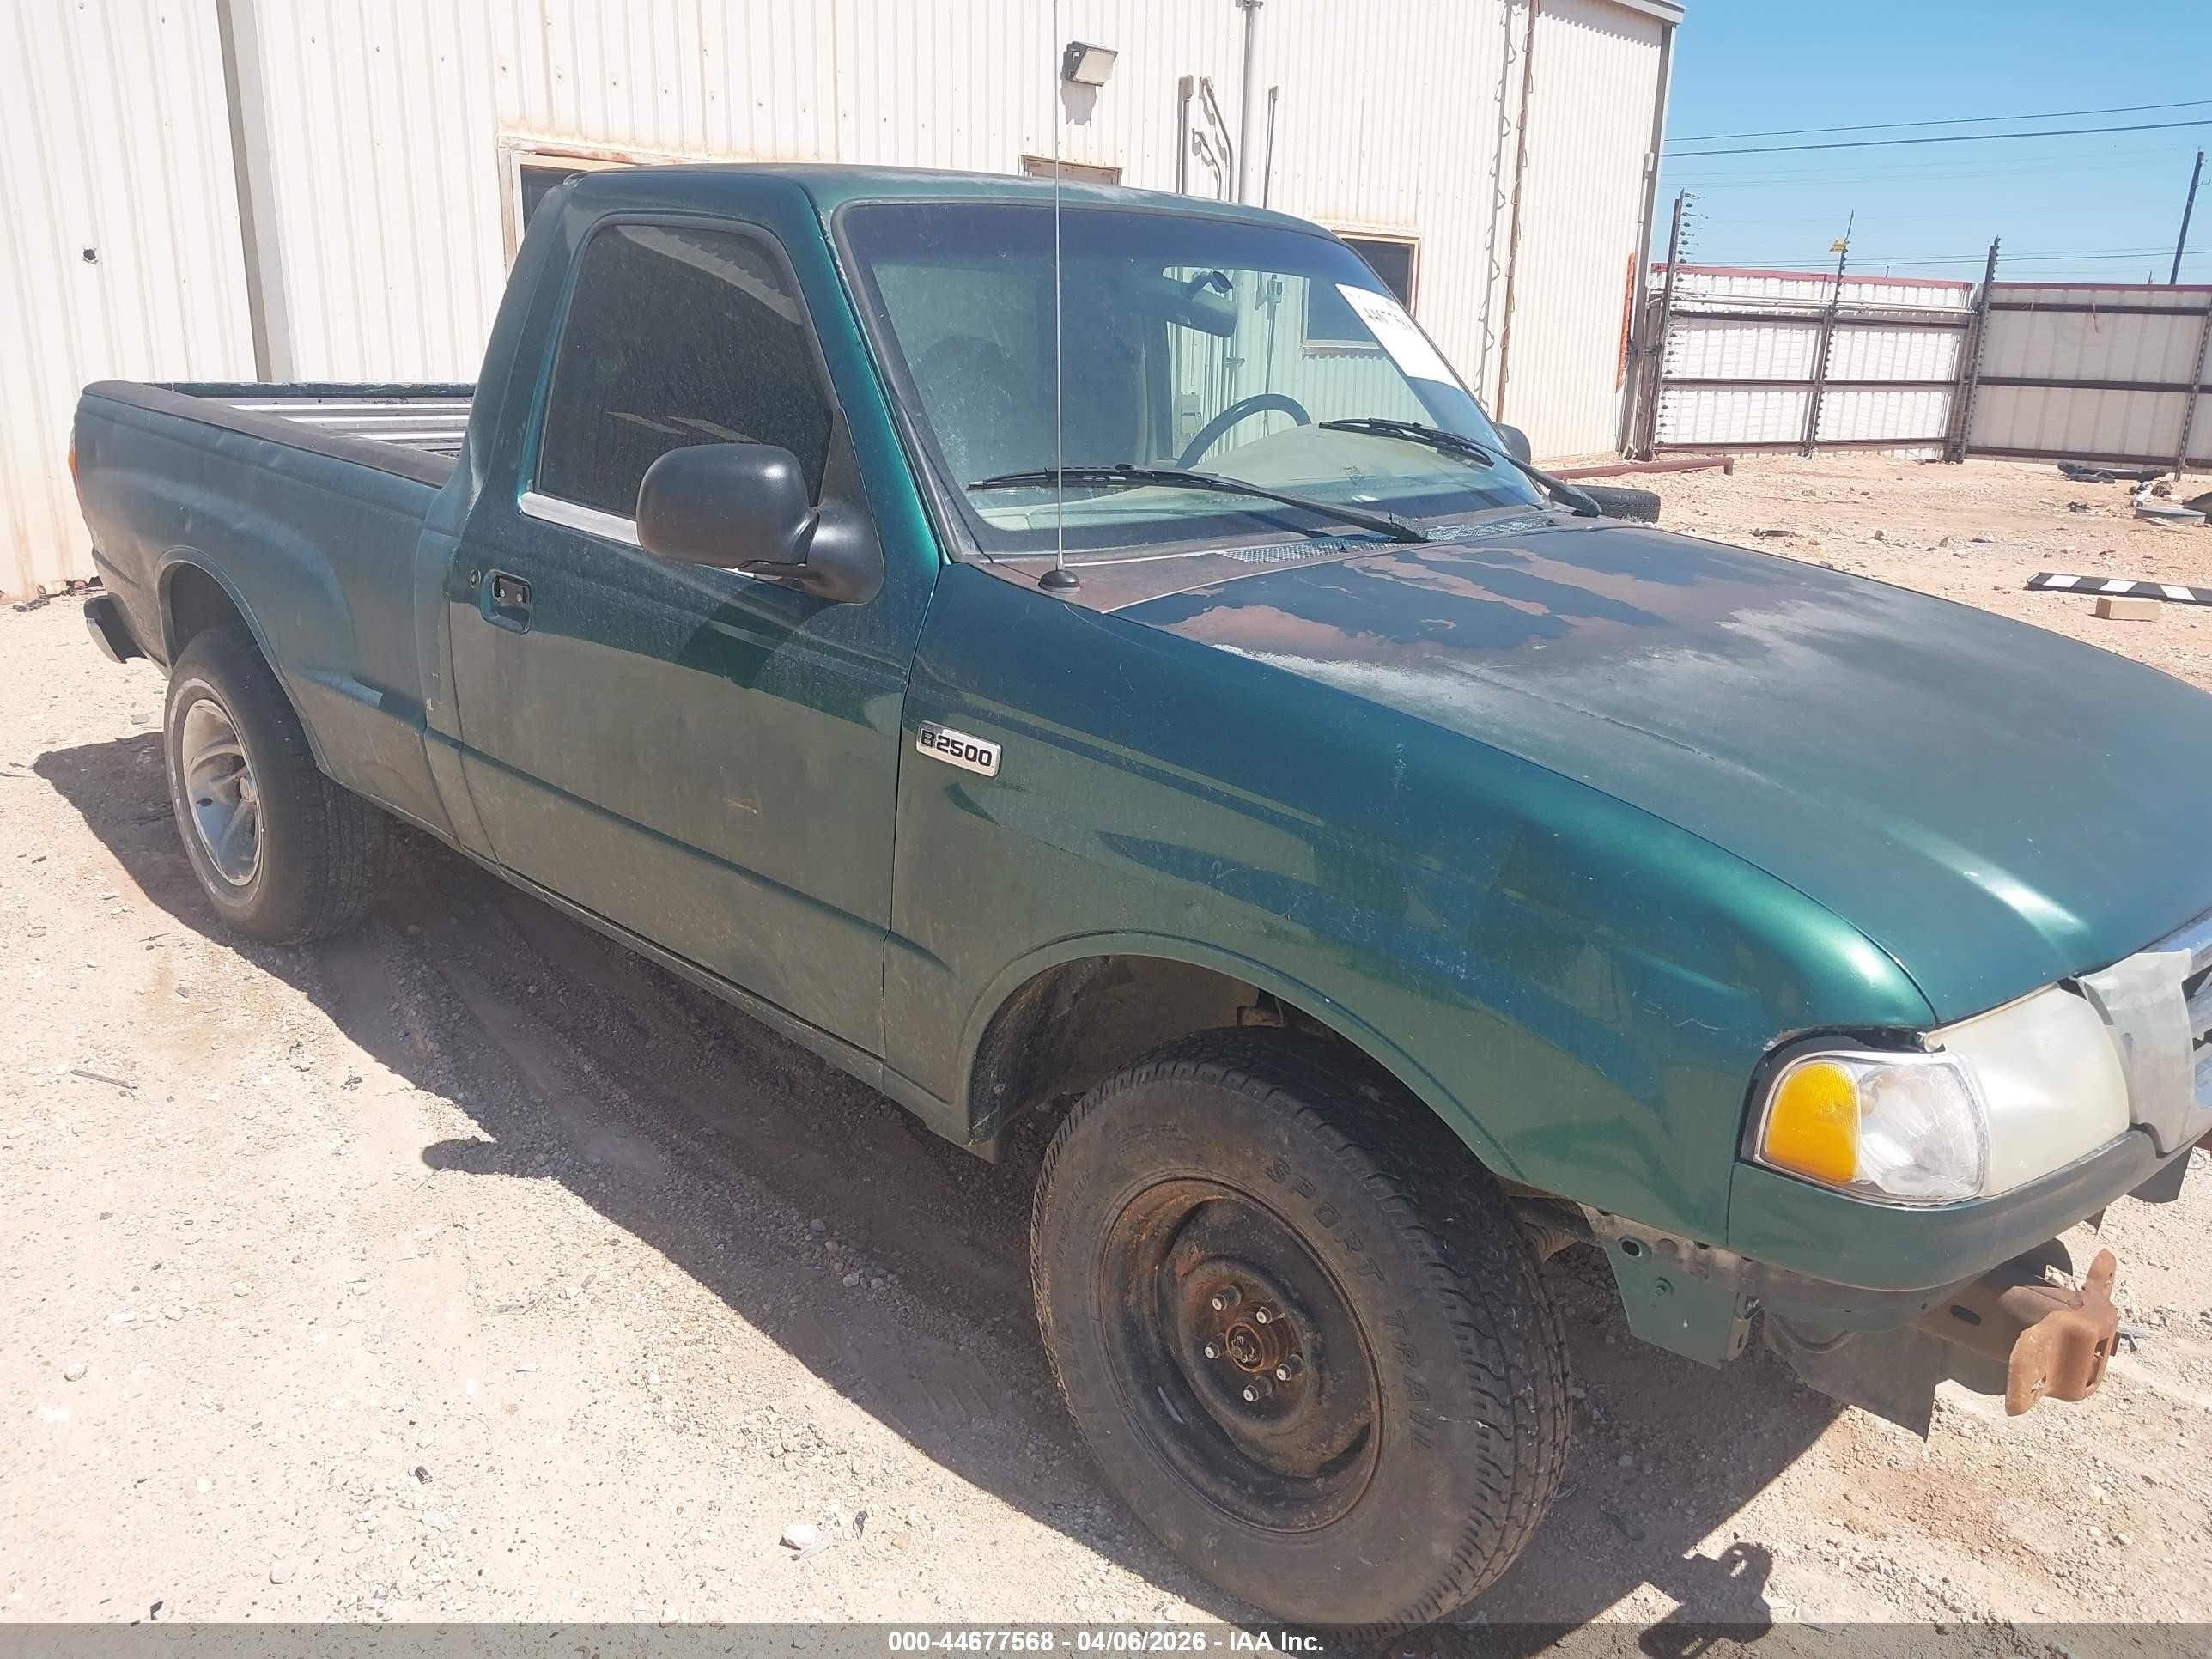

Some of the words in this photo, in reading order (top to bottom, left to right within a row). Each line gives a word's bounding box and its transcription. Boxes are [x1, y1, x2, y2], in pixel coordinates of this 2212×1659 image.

[920, 729, 993, 767] B2500
[1265, 1156, 1387, 1281] SPORT
[1384, 1310, 1436, 1450] TRAIL
